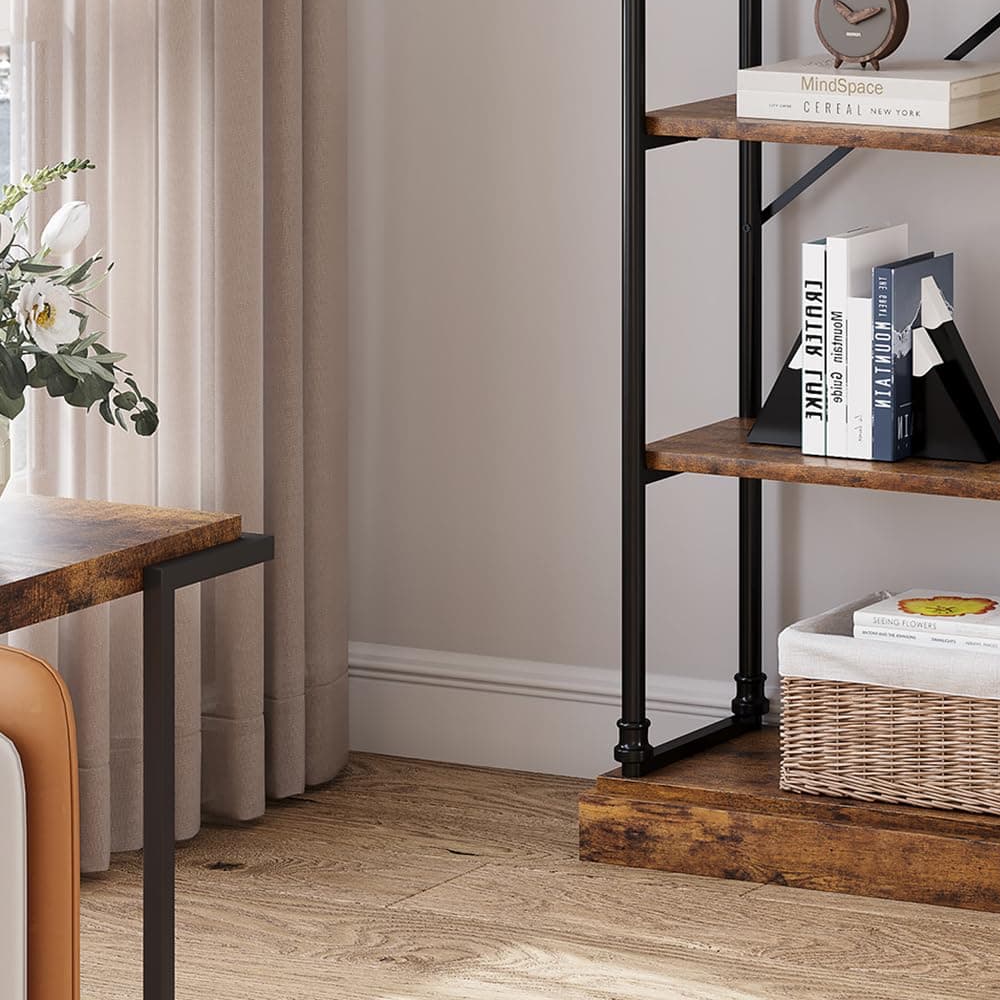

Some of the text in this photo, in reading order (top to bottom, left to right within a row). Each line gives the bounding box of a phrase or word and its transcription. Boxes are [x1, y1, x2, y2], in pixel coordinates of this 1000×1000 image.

[801, 76, 884, 96] MindSpace
[803, 100, 862, 116] CEREAL
[870, 107, 892, 116] NEW
[896, 109, 921, 117] YORK
[872, 616, 937, 630] SEEING FLOWERS
